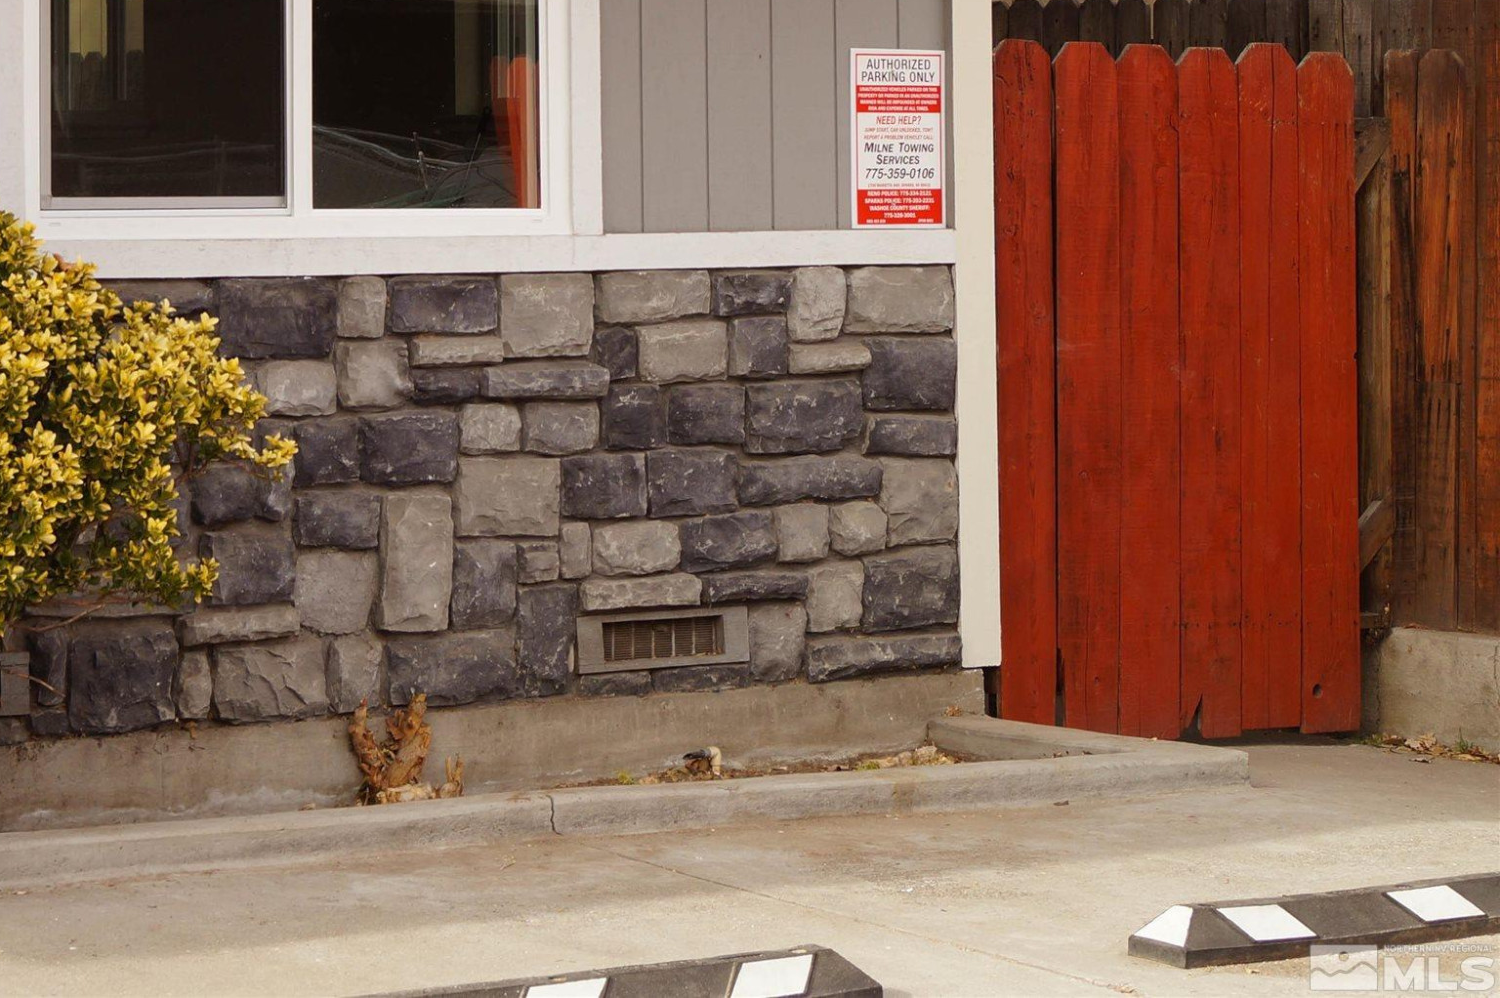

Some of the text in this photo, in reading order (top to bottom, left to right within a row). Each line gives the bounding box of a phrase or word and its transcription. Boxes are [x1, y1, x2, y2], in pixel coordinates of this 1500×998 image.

[866, 58, 931, 70] AUTHORIZED
[861, 71, 935, 83] PARKING ONLY
[876, 115, 922, 125] NEED HELP?
[864, 142, 934, 153] MILNE TOWING
[876, 154, 920, 165] SERVICES
[865, 168, 935, 179] 775-359-0106
